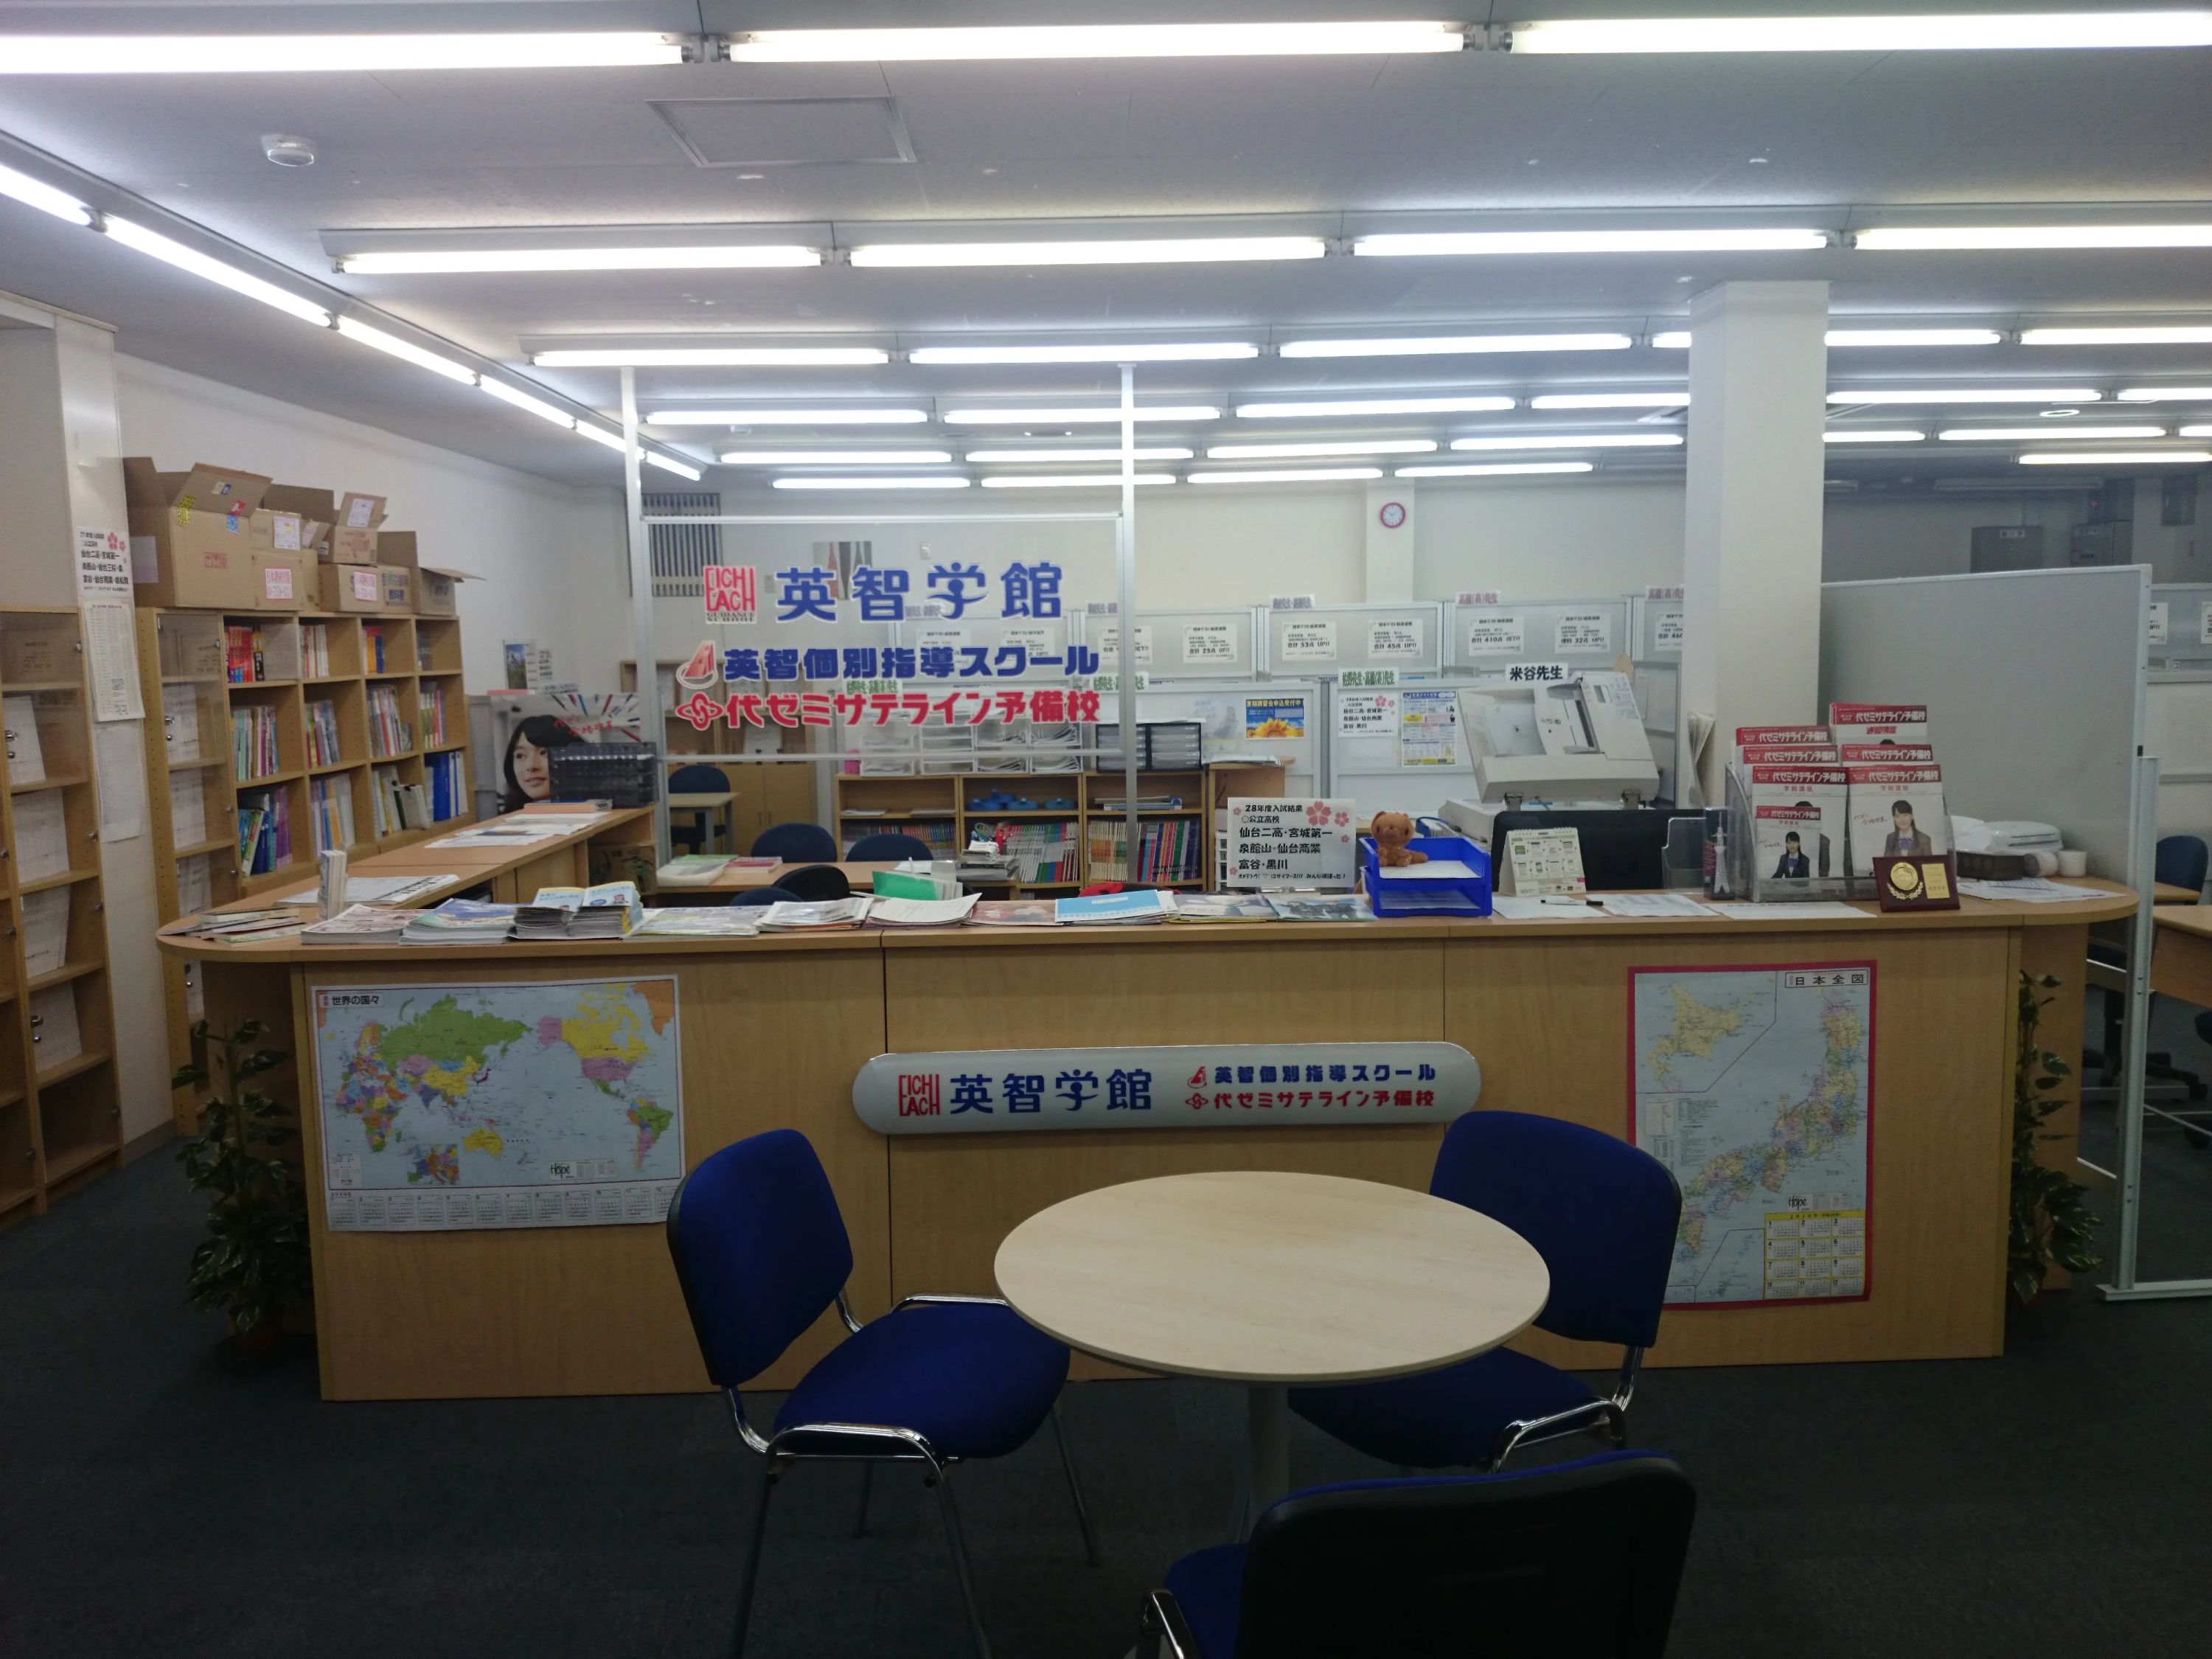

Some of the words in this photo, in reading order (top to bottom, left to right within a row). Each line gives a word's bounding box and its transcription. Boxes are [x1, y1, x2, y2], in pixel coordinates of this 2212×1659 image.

[776, 561, 1062, 621] 英智学館
[724, 647, 1099, 679] 英智個別指導スクール
[1509, 665, 1563, 681] 米谷先生
[726, 691, 1101, 726] 代ゼミサテライン予備校
[1856, 711, 1926, 722] 代ゼミサテライン予備校
[1759, 731, 1828, 742] 代ゼミサテライン予備校
[1764, 751, 1836, 762] 代ゼミサテライン予備校
[1861, 748, 1932, 759] 代ゼミサテライン予備校
[1773, 772, 1846, 782] 代ゼミサテライン予備校
[1868, 771, 1938, 782] 代ゼミサテライン予備校
[1245, 804, 1303, 813] 28年度入試結果
[1771, 810, 1819, 819] 代ゼミサテライン予備校
[1239, 827, 1333, 838] 仙台二高・宮城第一
[1239, 843, 1321, 854] 泉館山・仙台商業
[1239, 859, 1288, 870] 富谷・黒川
[1795, 974, 1863, 986] 日本全図
[332, 995, 379, 1005] 世界の国々
[1215, 1064, 1436, 1084] 英智個別指導スクール
[950, 1068, 1153, 1116] 英智学館
[1214, 1089, 1435, 1110] 代ゼミサテライン予備校
[550, 1162, 571, 1178] Hope
[1788, 1194, 1808, 1211] Hope
